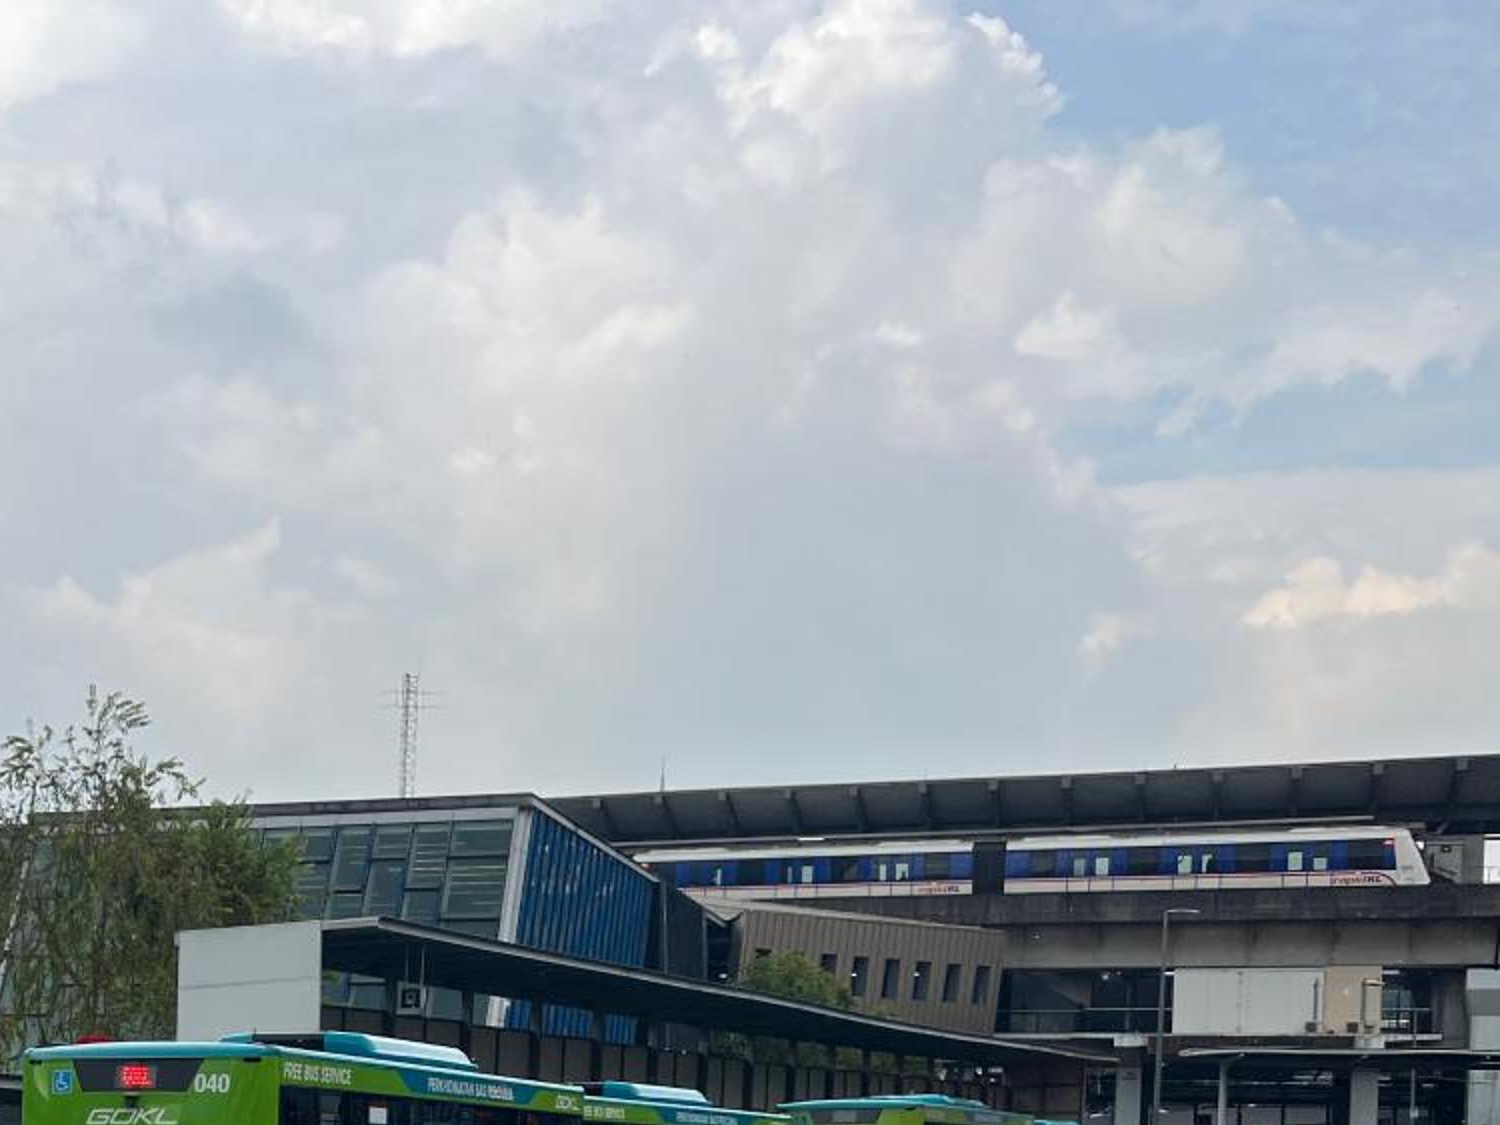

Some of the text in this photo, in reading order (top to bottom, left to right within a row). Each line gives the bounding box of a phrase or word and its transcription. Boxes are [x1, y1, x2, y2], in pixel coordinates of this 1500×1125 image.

[194, 1073, 231, 1093] 040
[283, 1061, 352, 1085] FREE BUS SERVICE
[85, 1107, 179, 1125] GOKL
